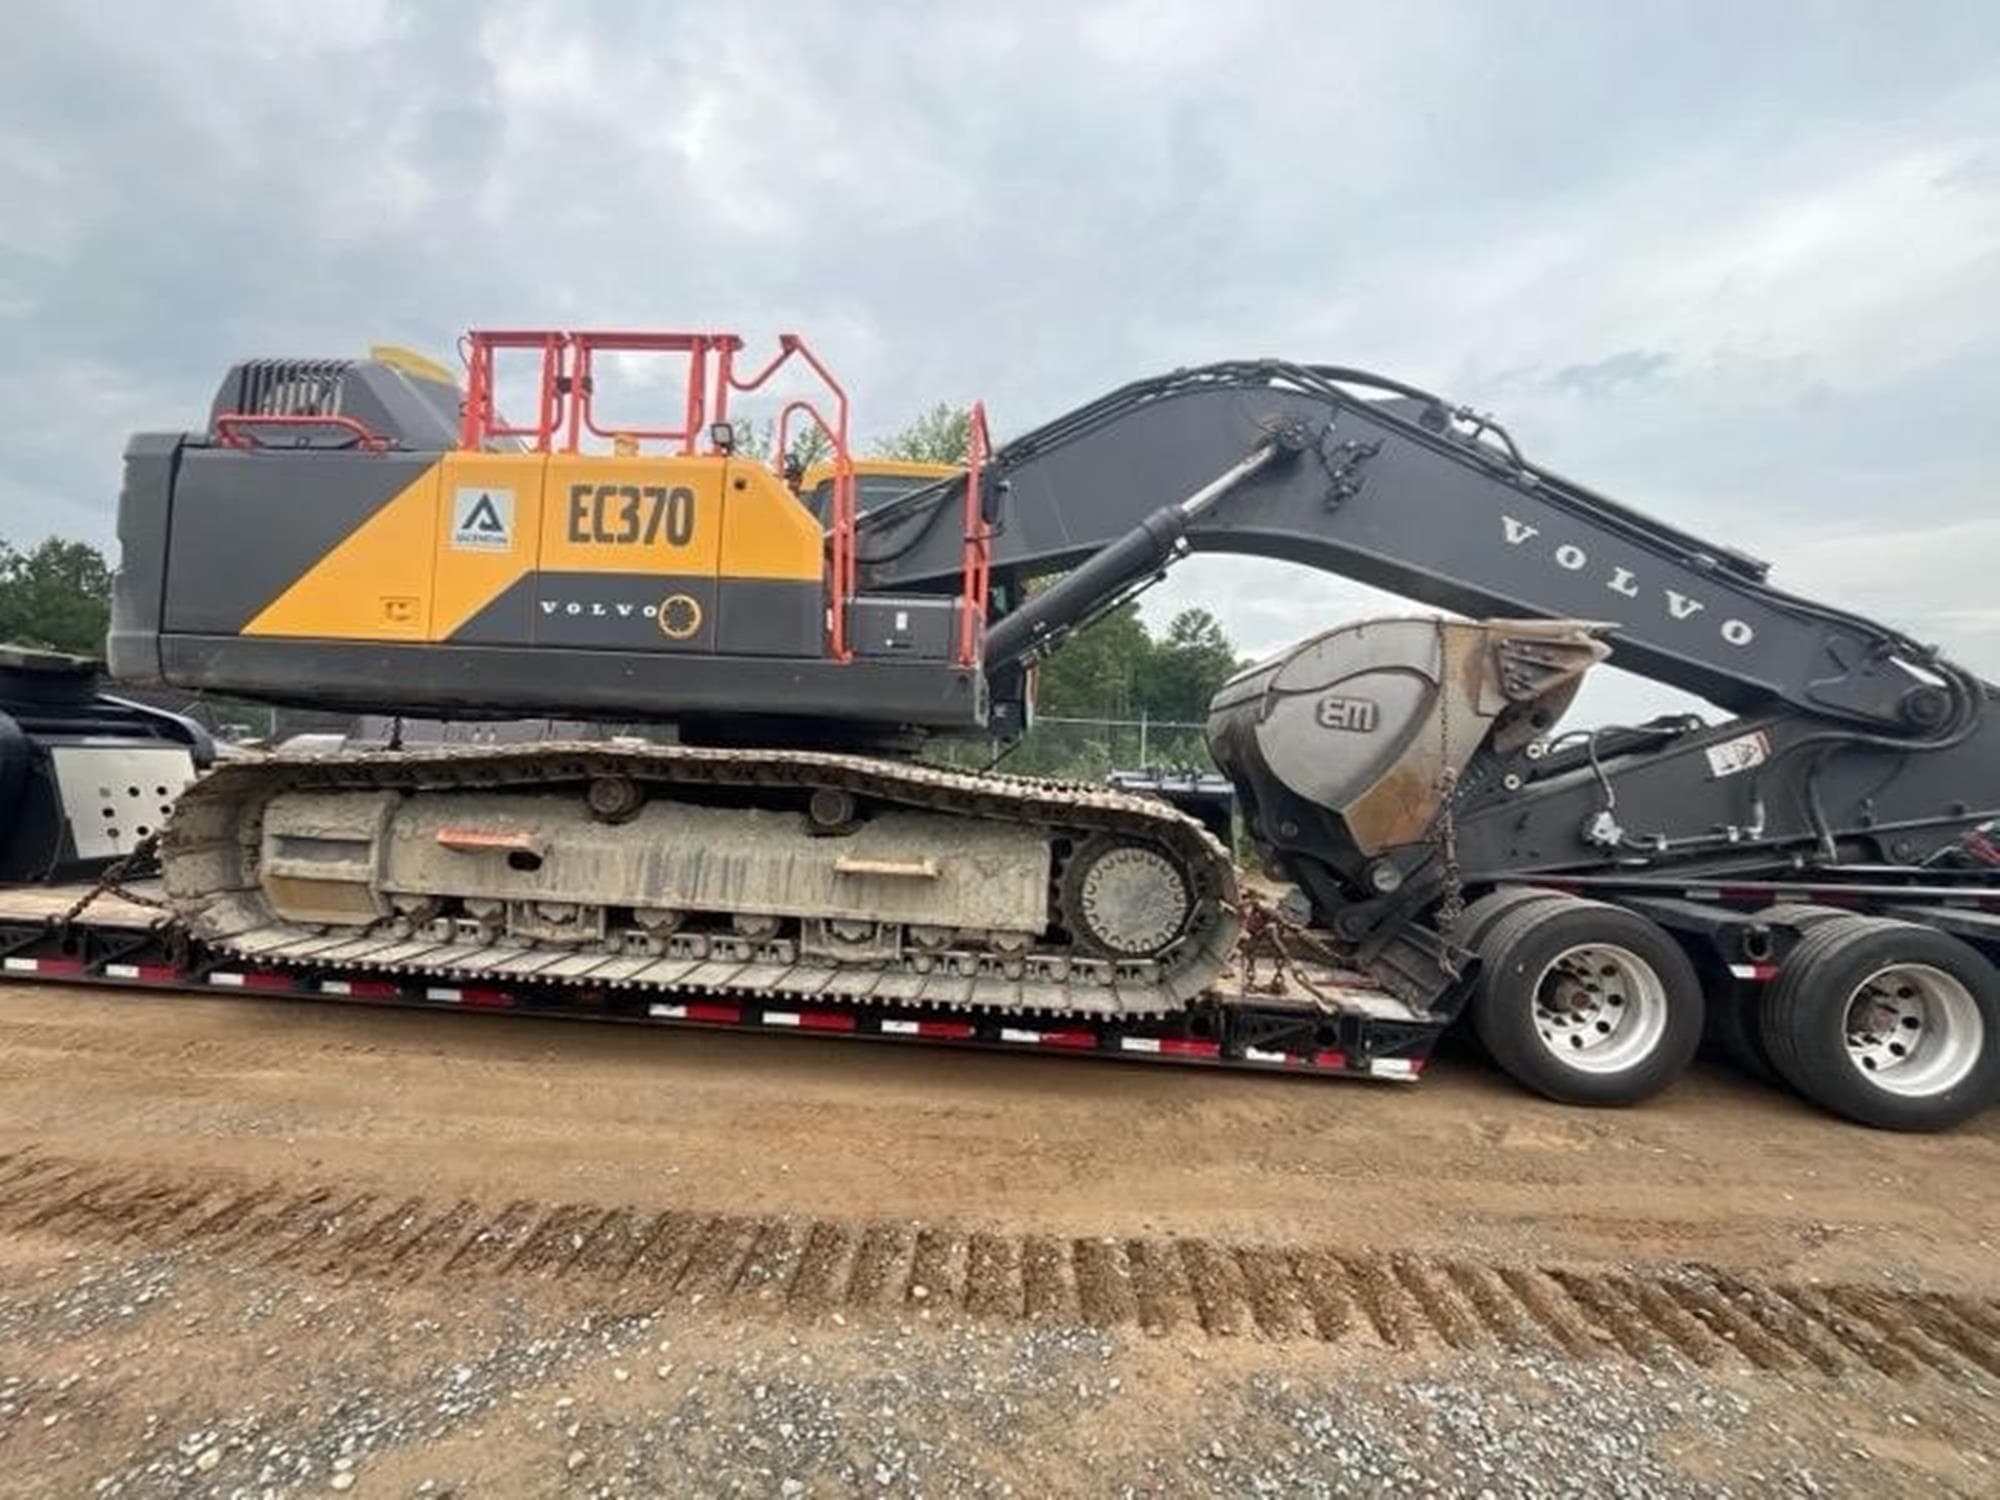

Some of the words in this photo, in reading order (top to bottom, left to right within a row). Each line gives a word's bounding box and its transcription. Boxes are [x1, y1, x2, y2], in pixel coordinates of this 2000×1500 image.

[569, 485, 694, 546] EC370
[541, 600, 659, 618] VOLVO
[1501, 515, 1753, 646] VOLVO
